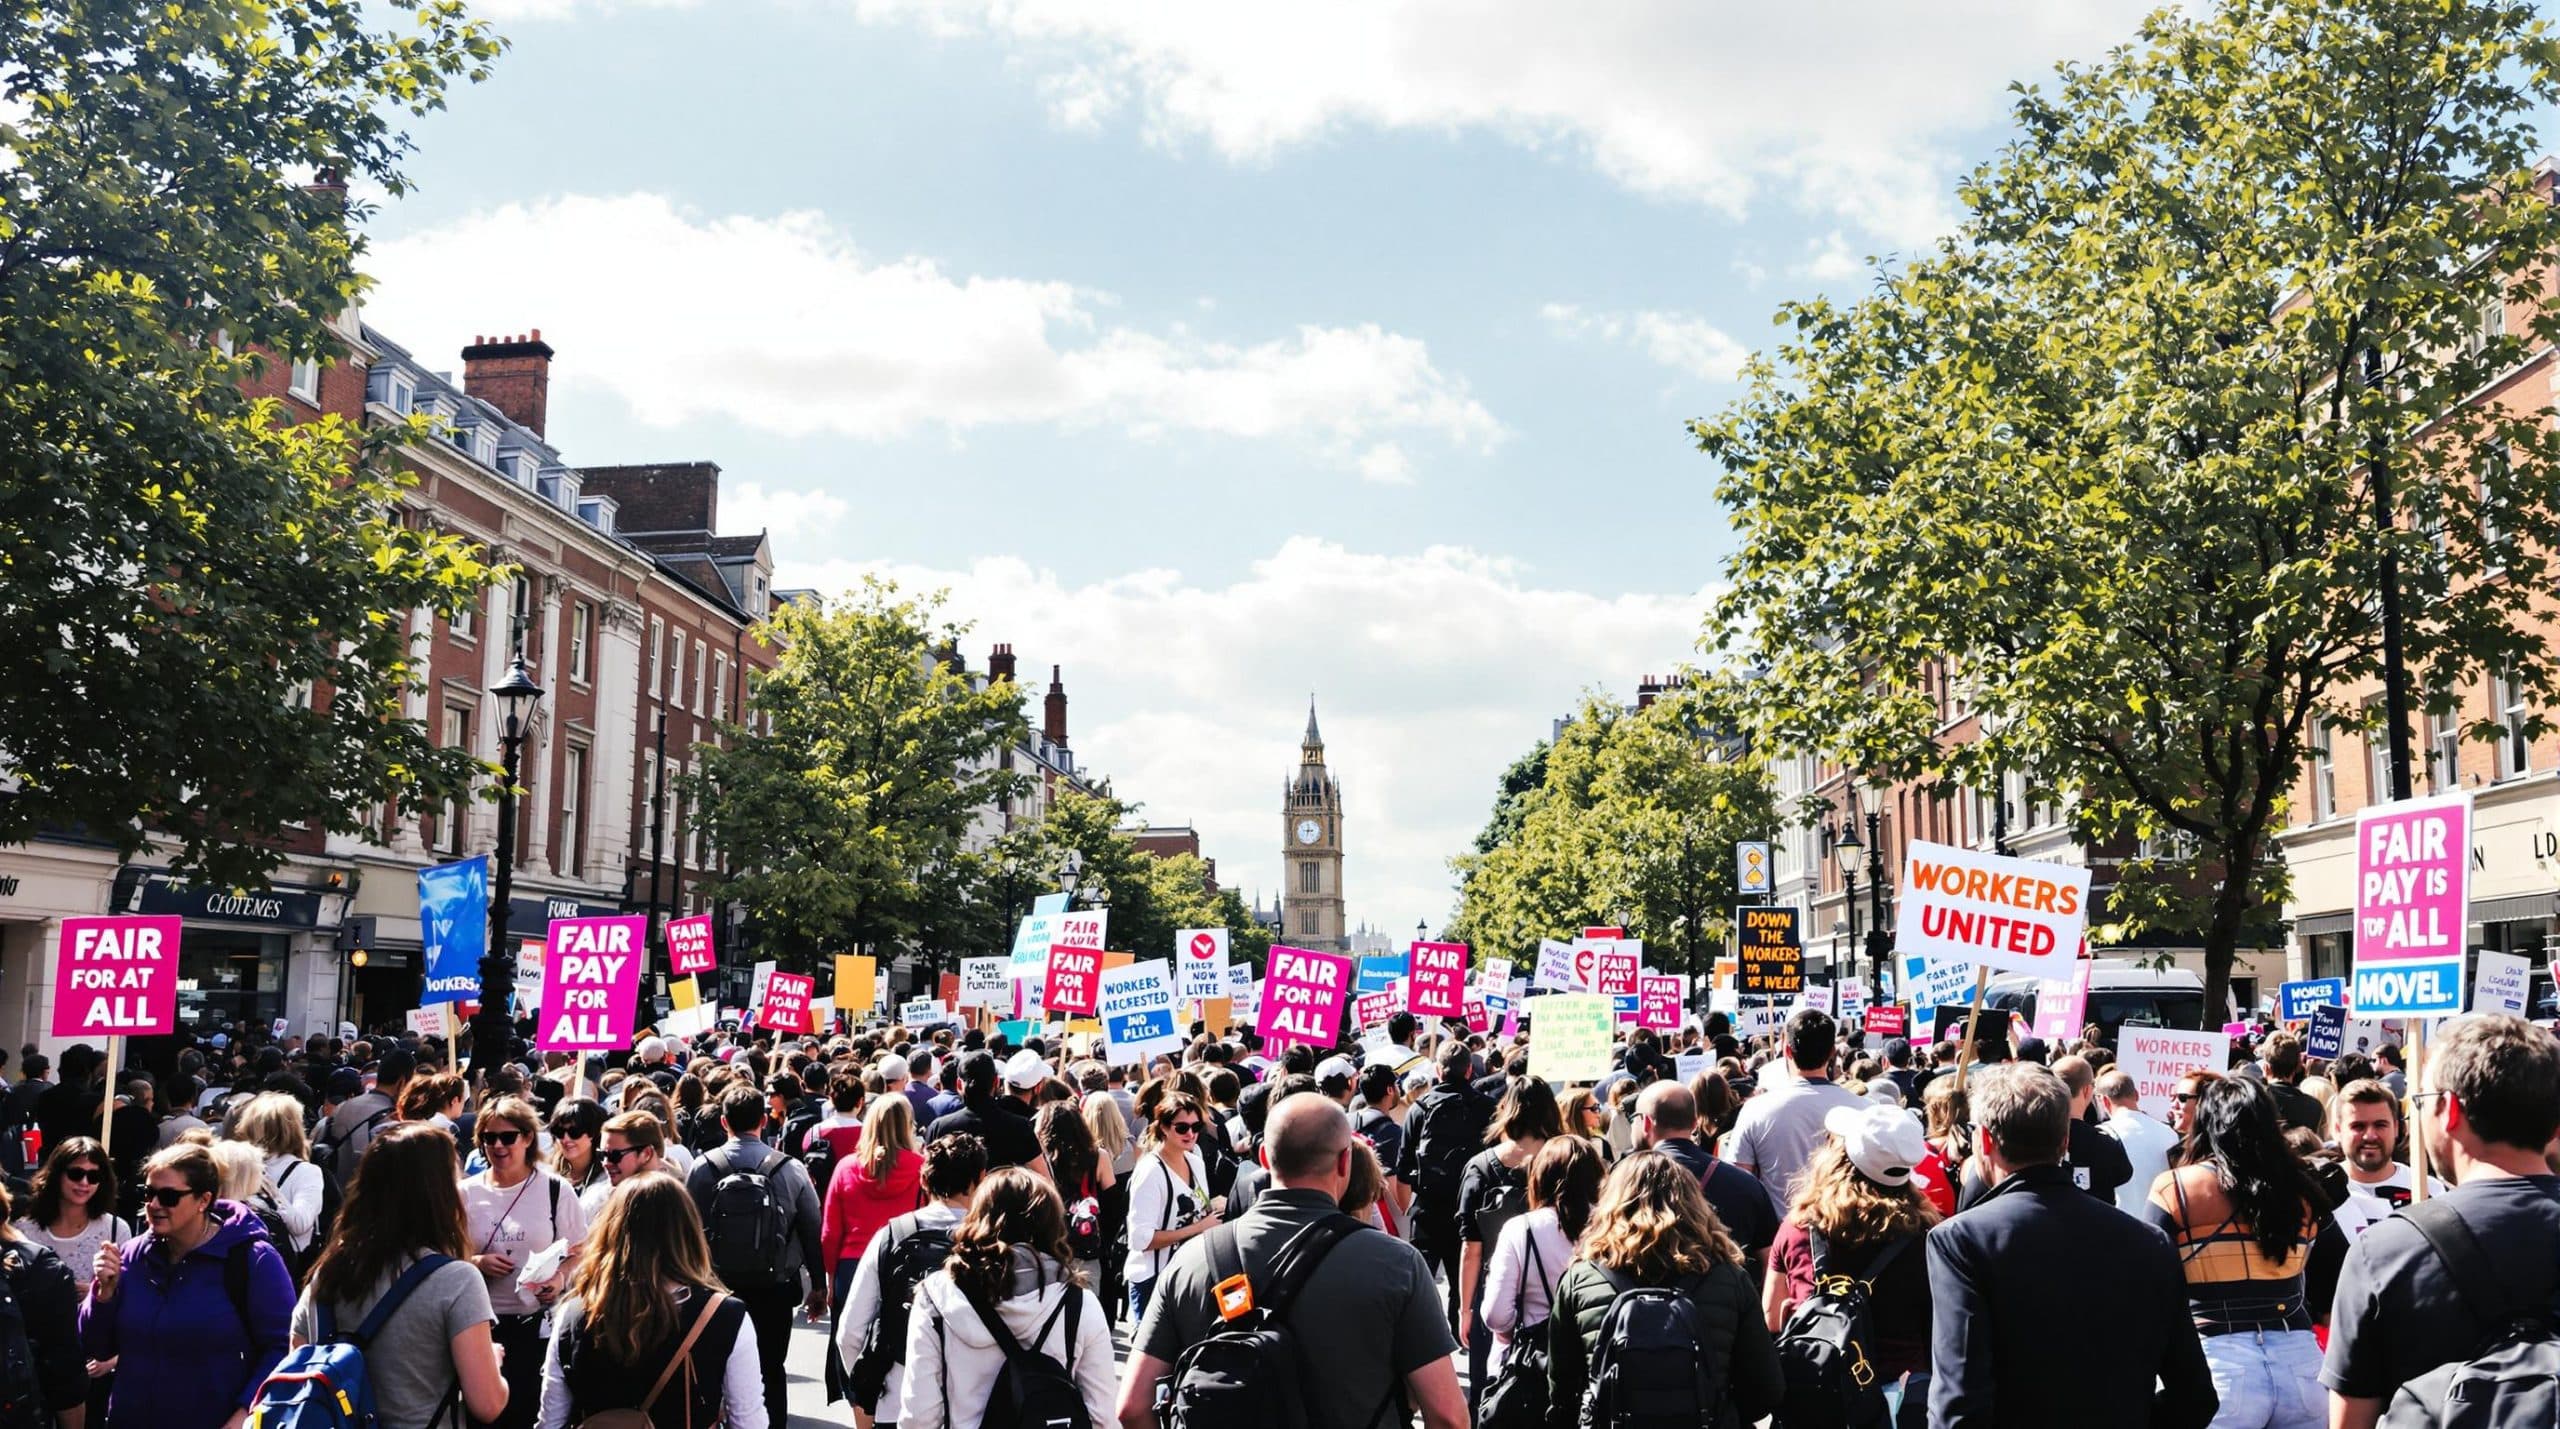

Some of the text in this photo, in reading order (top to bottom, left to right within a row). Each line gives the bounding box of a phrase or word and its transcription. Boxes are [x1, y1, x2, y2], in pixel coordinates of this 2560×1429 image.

[2370, 817, 2448, 866] FAIR
[1912, 859, 2079, 915] WORKERS
[2363, 868, 2448, 908] PAY IS
[1064, 921, 1099, 934] FAIR
[1746, 911, 1792, 928] DOWN
[2385, 908, 2448, 948] ALL
[557, 925, 631, 953] FAIR
[671, 923, 708, 941] FAIR
[1758, 929, 1785, 944] THE
[1921, 904, 2056, 957] UNITED
[74, 927, 163, 961] FAIR
[1743, 944, 1801, 962] WORKERS
[680, 954, 710, 970] ALL
[1052, 952, 1095, 973] FAIR
[1416, 947, 1460, 970] FAIR
[1601, 956, 1632, 970] FAIR
[71, 969, 116, 990] FOR
[120, 967, 154, 988] AT
[560, 956, 627, 984] PAY
[1193, 971, 1218, 980] NOW
[1273, 953, 1338, 988] FAIR
[772, 976, 807, 997] FAIR
[1055, 973, 1083, 988] FOR
[1104, 976, 1160, 995] WORKERS
[1602, 981, 1627, 993] ALL
[1643, 979, 1677, 994] FAIR
[2358, 970, 2453, 1006] MOVEL.
[563, 989, 608, 1009] FOR
[1053, 988, 1086, 1007] ALL
[1273, 983, 1333, 1006] FOR IN
[1418, 989, 1453, 1009] ALL
[82, 996, 157, 1027] ALL
[769, 1010, 798, 1027] ALL
[1647, 1011, 1672, 1024] ALL
[548, 1014, 617, 1043] ALL
[1270, 1007, 1328, 1038] ALL
[2135, 1038, 2212, 1057] WORKERS
